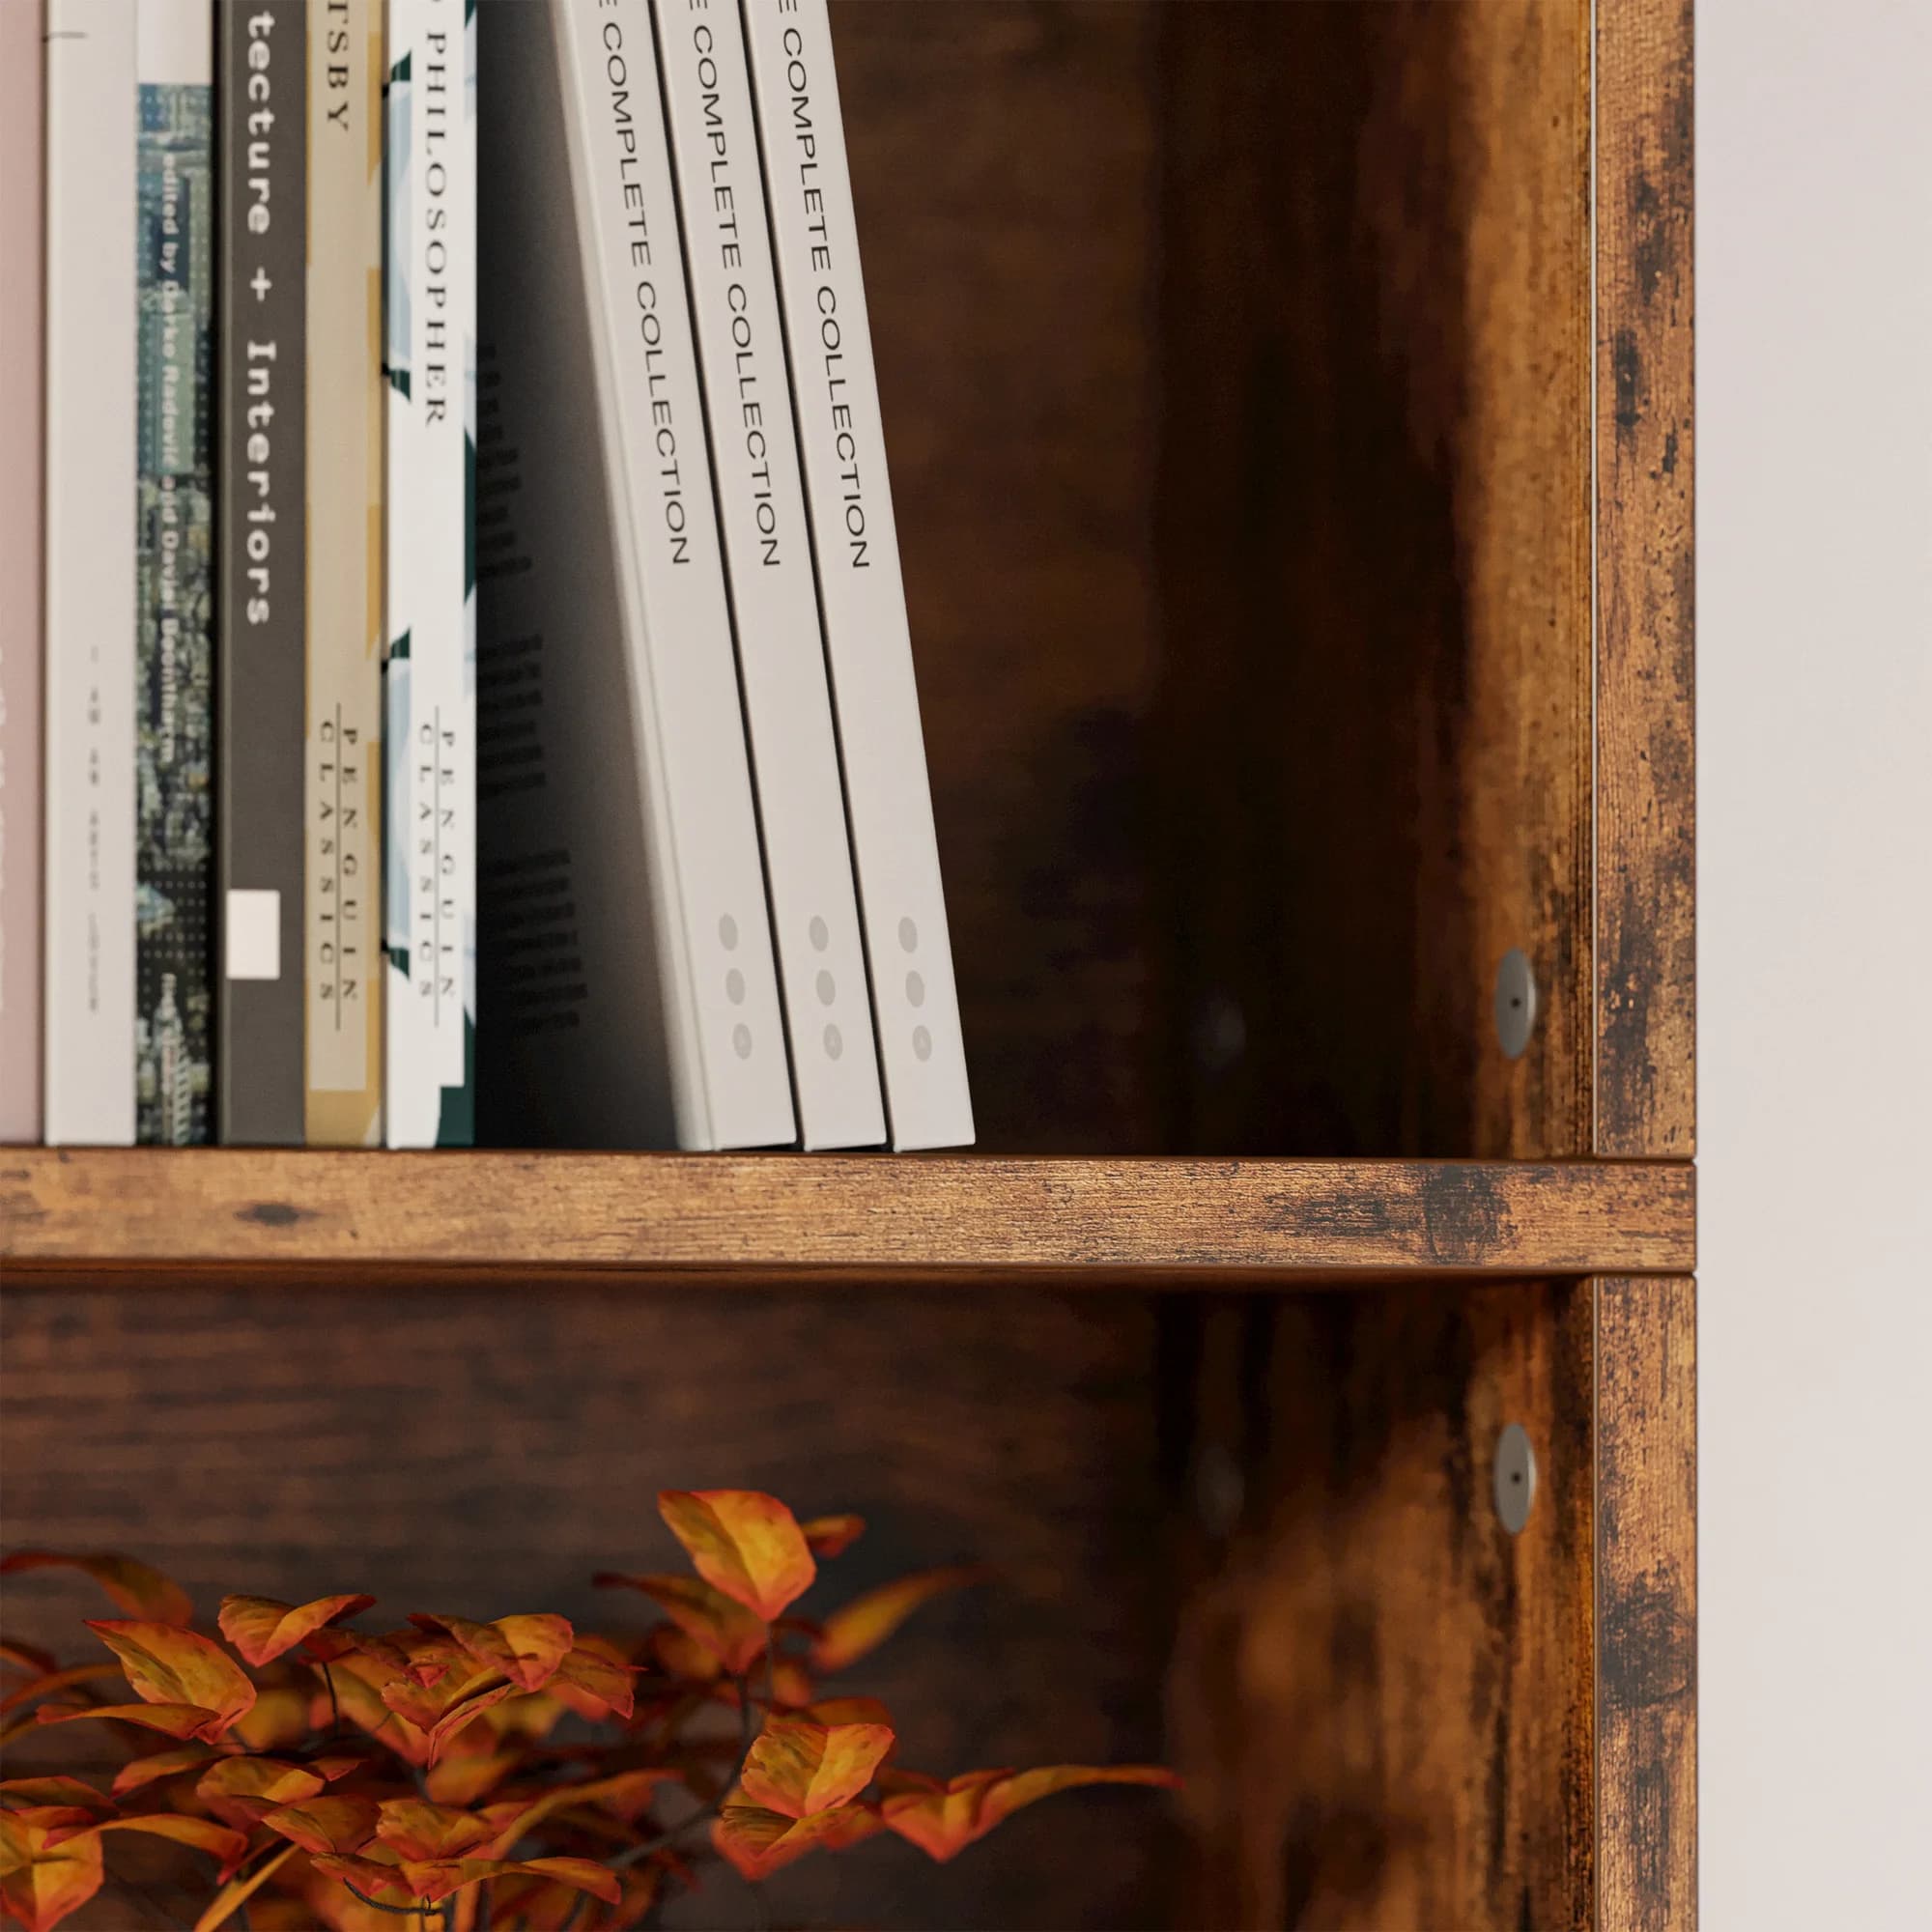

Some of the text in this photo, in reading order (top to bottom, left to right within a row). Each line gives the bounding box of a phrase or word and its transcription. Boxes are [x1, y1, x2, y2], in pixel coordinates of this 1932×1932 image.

[161, 153, 180, 236] edited
[247, 11, 275, 234] tecture
[327, 0, 350, 131] TSBY
[159, 242, 180, 273] by
[425, 32, 447, 425] PHILOSOPHER
[603, 21, 691, 564] COMPLETE COLLECTION
[693, 24, 781, 567] COMPLETE COLLECTION
[782, 27, 832, 272] COMPLETE
[816, 285, 870, 569] COLLECTION
[246, 341, 277, 624] Interiors
[319, 720, 335, 1001] CLASSICS
[342, 727, 359, 1000] PENGUIN
[418, 723, 434, 998] CLASSICS
[440, 730, 456, 996] PENGUIN
